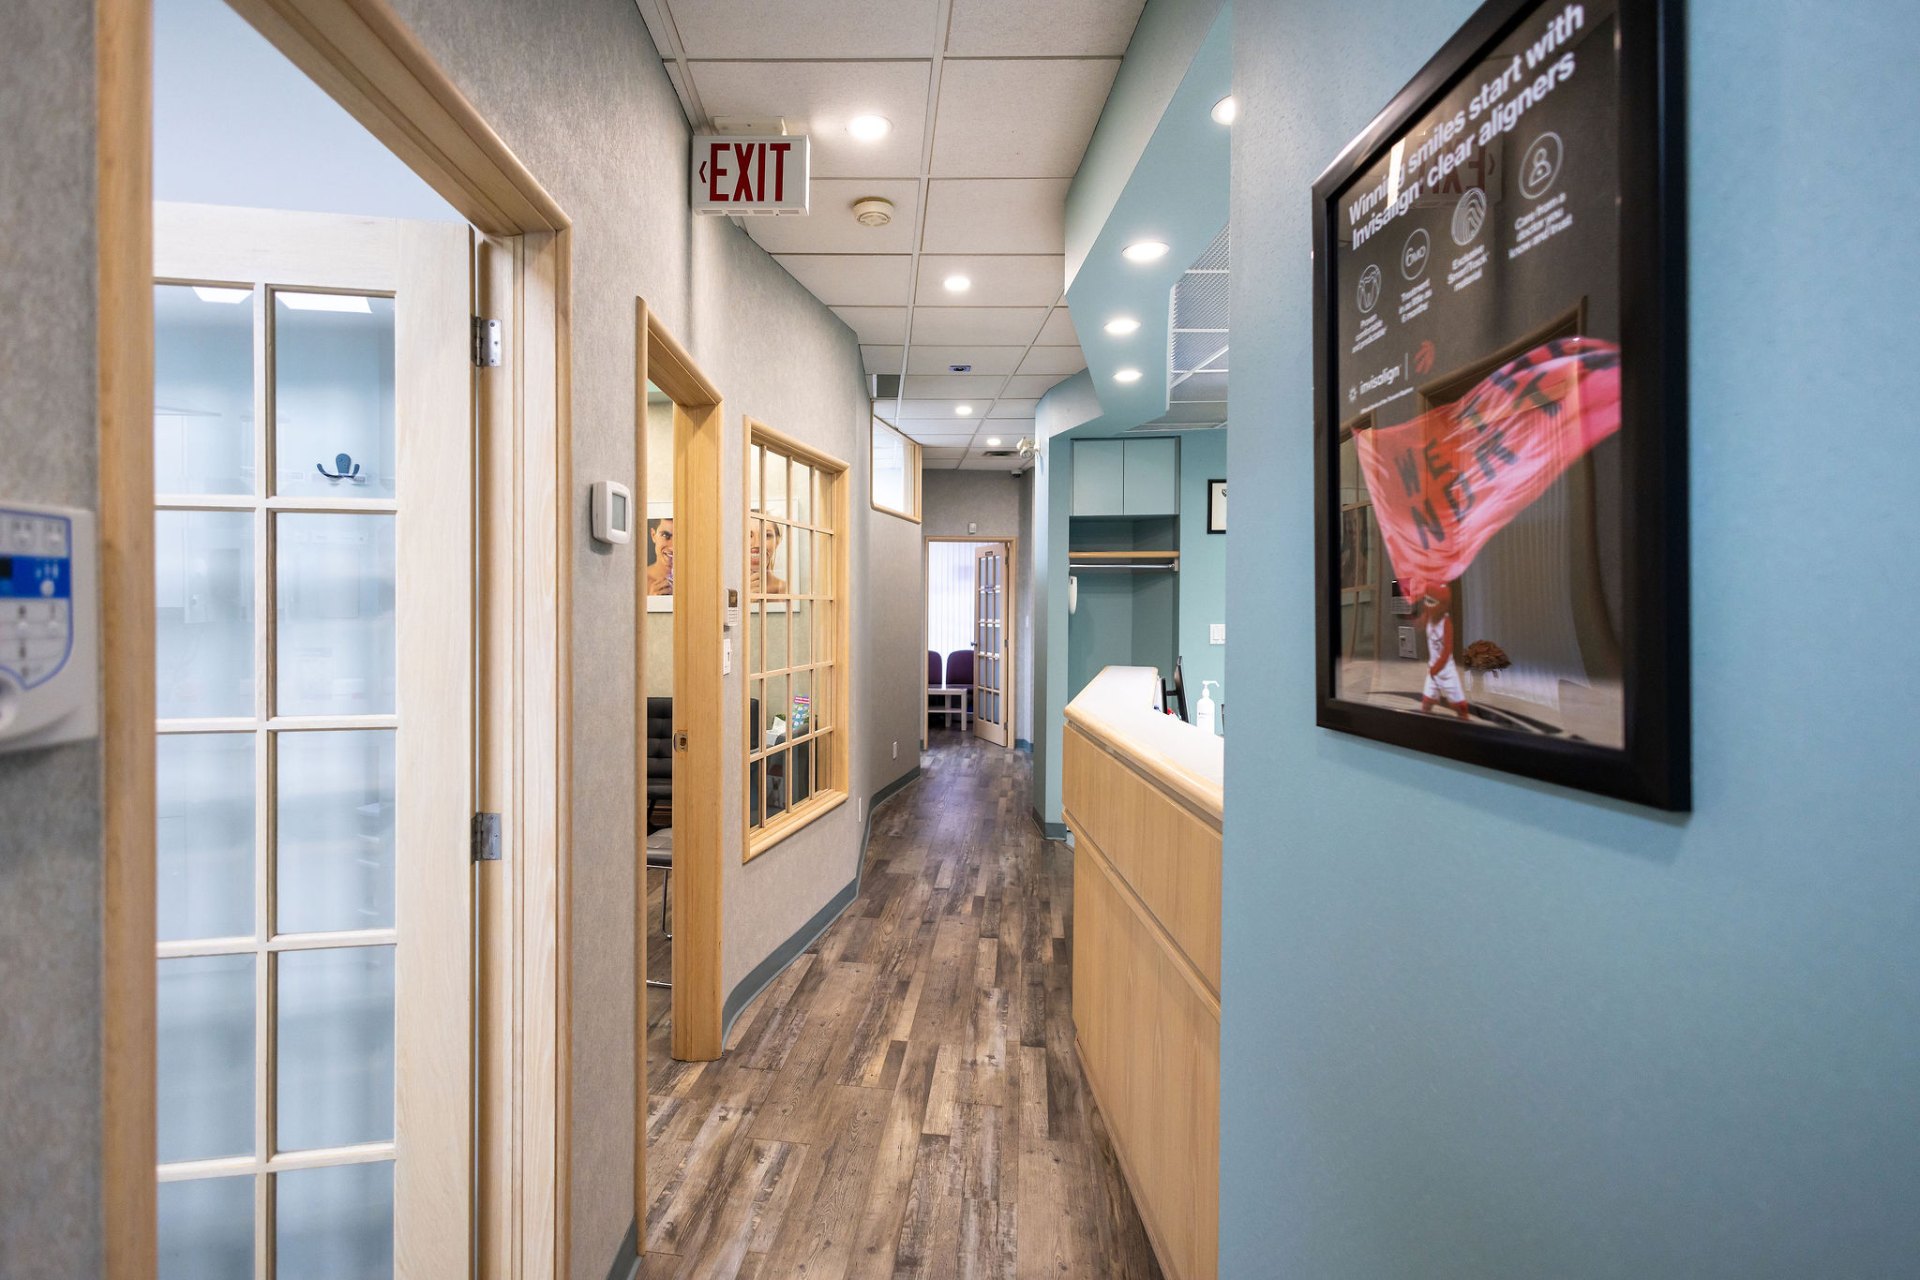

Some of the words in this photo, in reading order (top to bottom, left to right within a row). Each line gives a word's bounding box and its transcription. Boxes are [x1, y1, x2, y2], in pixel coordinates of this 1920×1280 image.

[709, 143, 791, 202] EXIT
[1349, 162, 1405, 226] Winnig
[1407, 108, 1466, 174] smiles
[1469, 57, 1522, 121] start
[1524, 4, 1584, 70] with
[1427, 134, 1476, 188] clear
[1478, 53, 1576, 147] aligners
